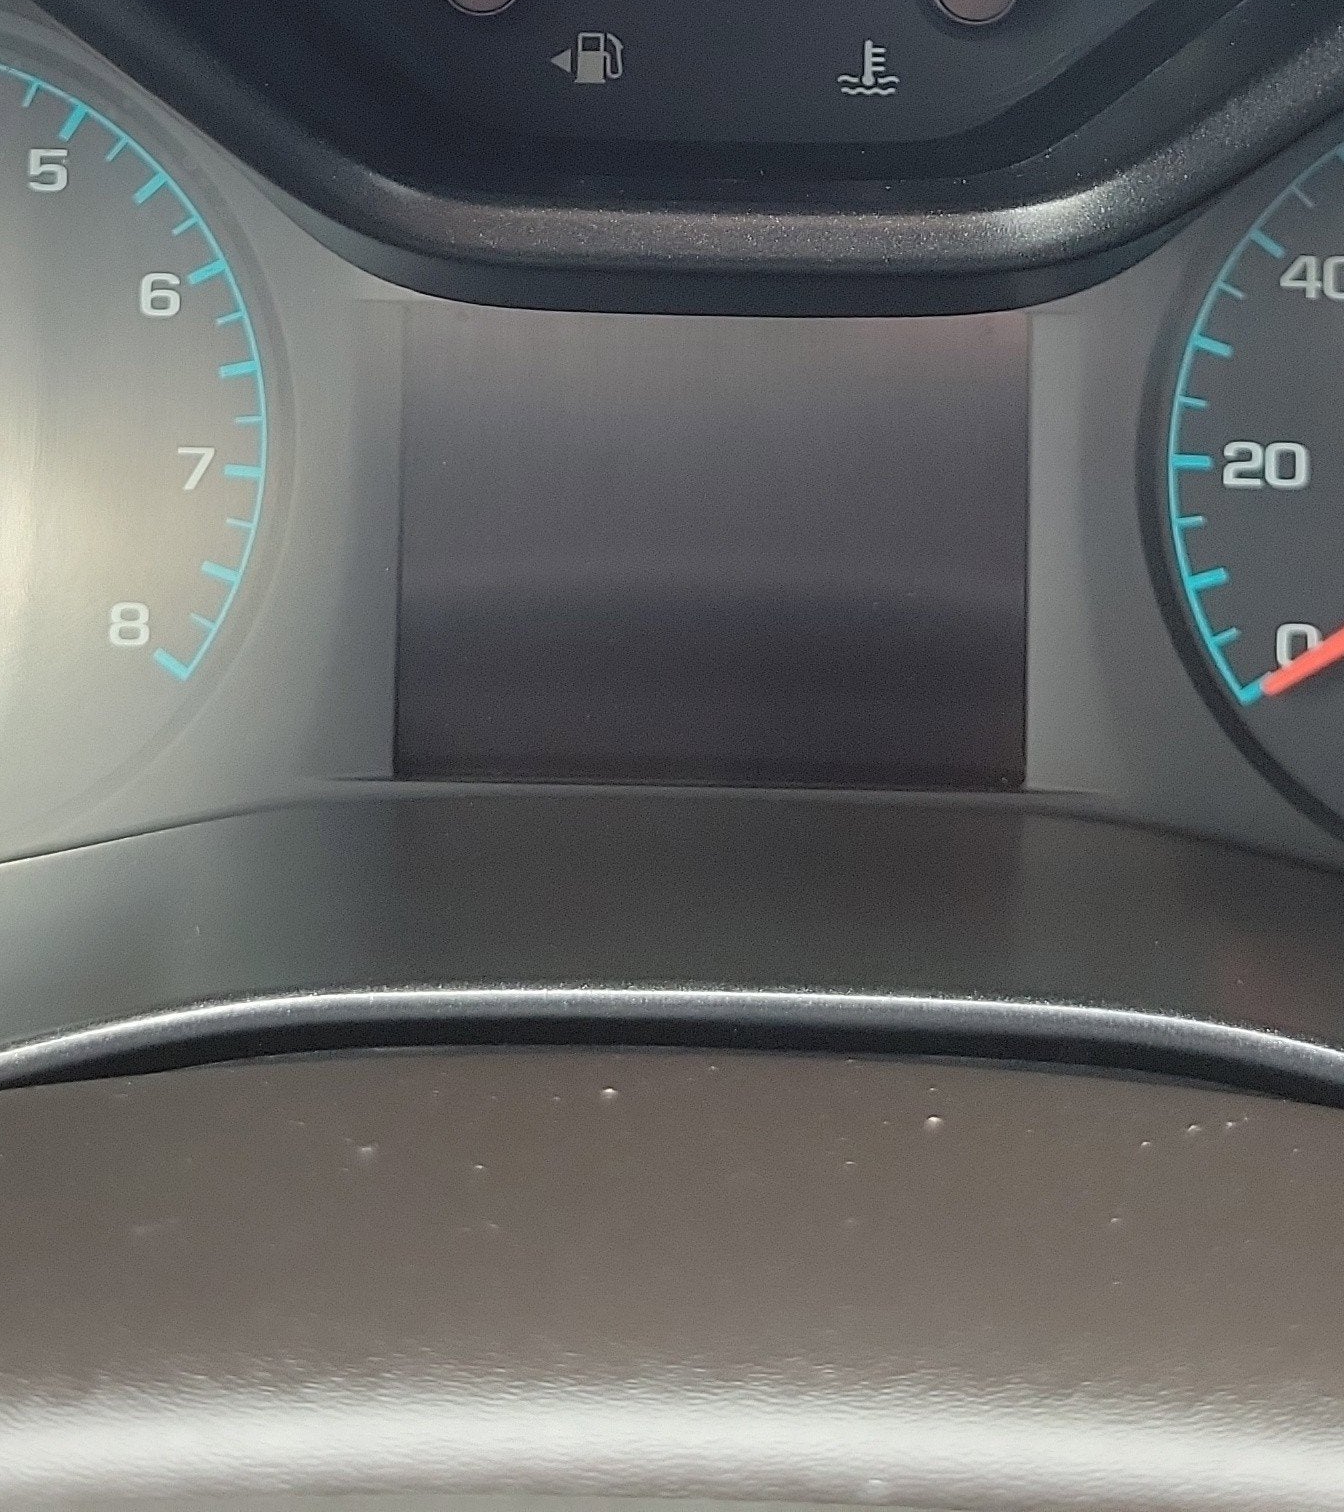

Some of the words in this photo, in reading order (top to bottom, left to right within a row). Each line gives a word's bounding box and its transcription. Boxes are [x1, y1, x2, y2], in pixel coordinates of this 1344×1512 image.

[27, 148, 70, 193] 5
[139, 272, 182, 319] 6
[176, 446, 216, 492] 7
[1222, 440, 1311, 490] 20
[106, 600, 152, 649] 8
[1275, 622, 1323, 669] 0
